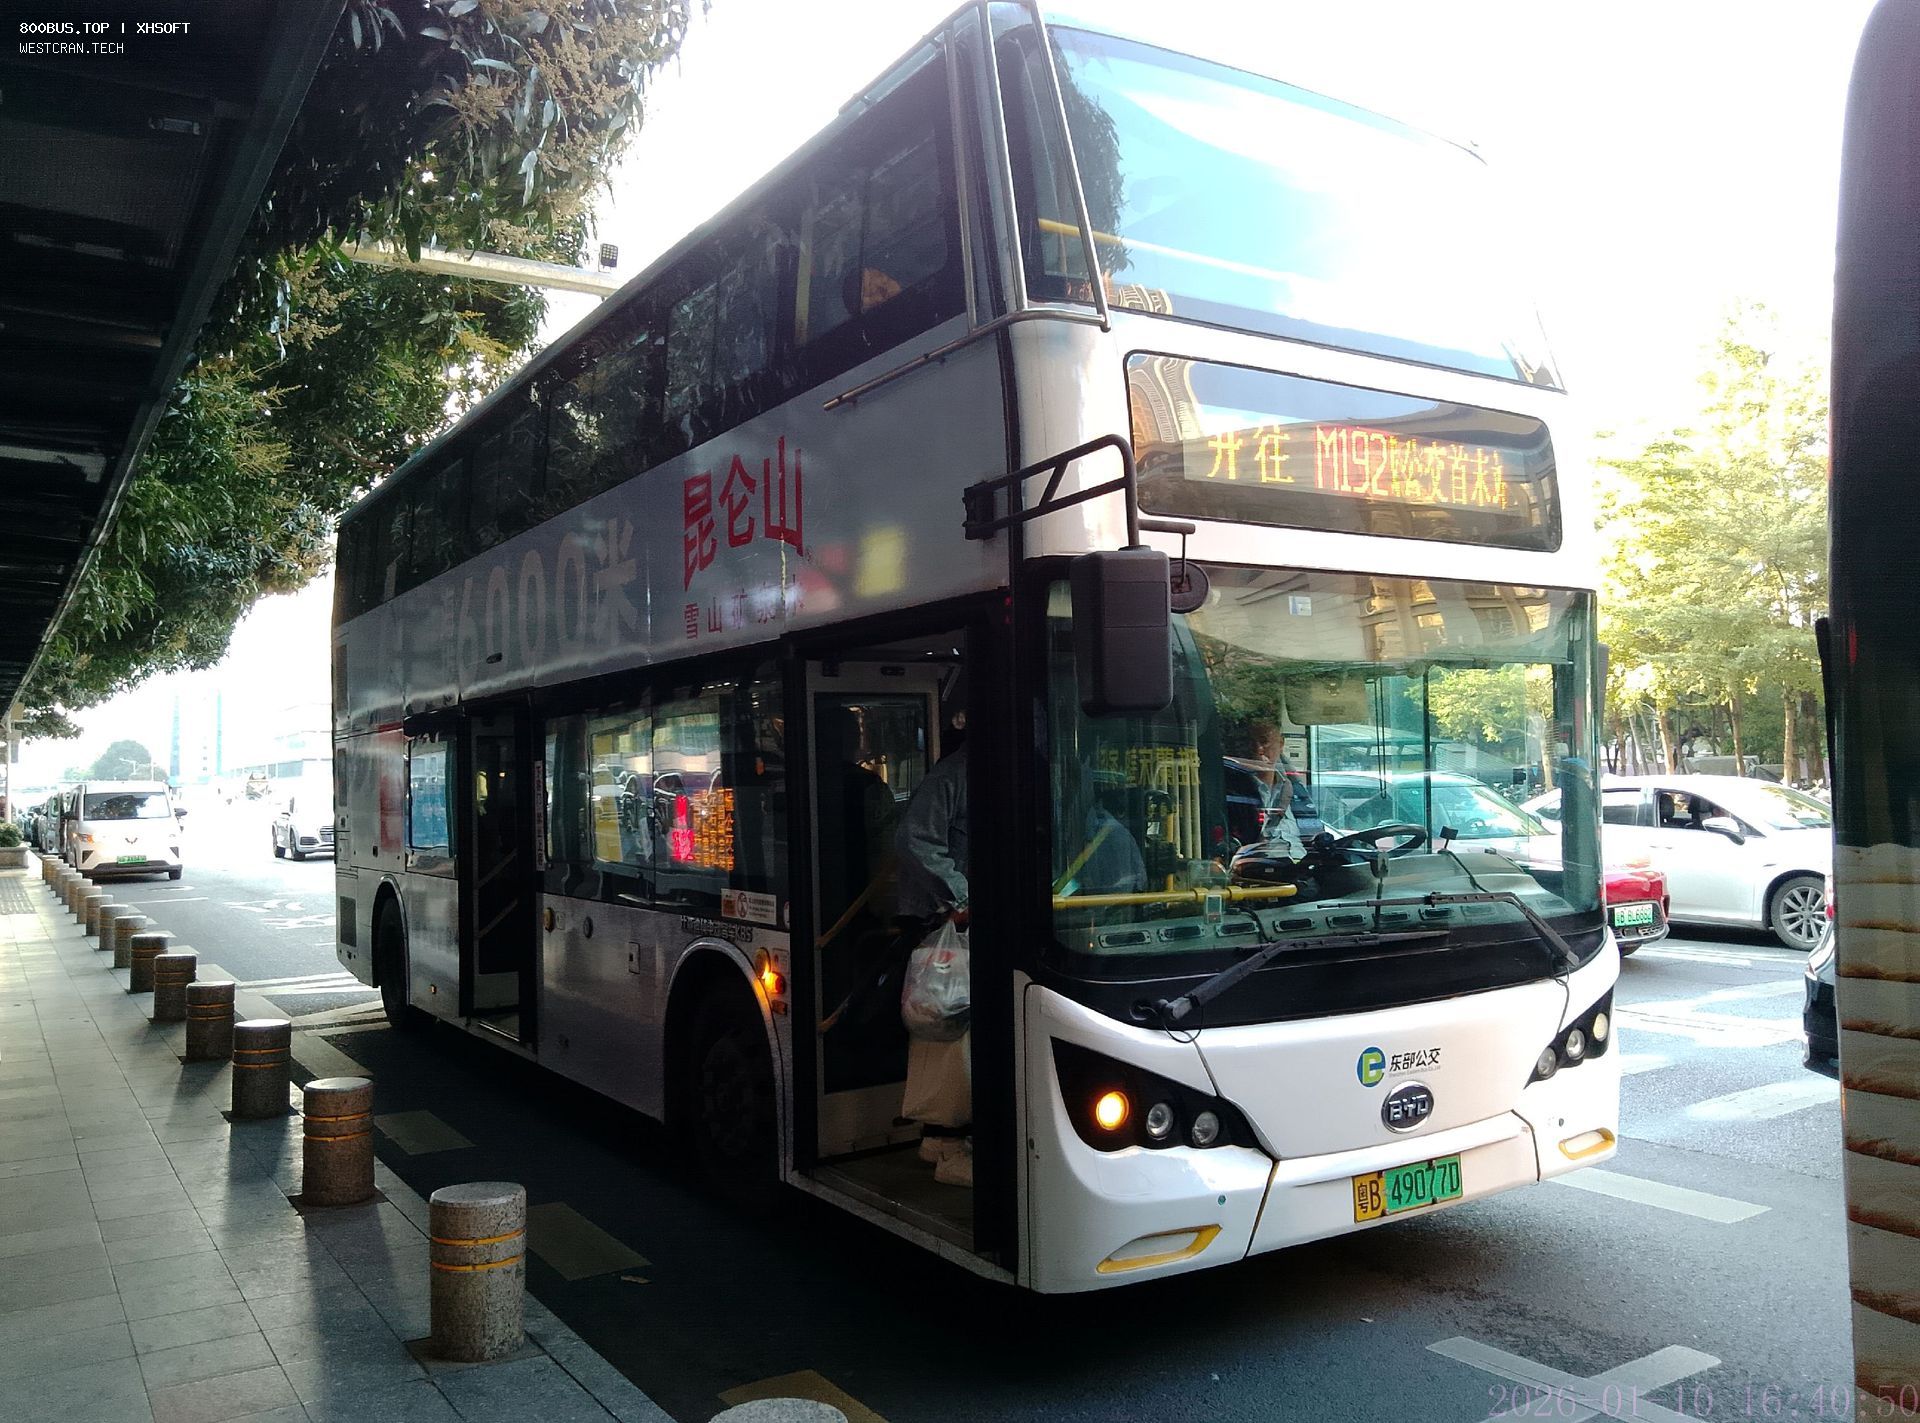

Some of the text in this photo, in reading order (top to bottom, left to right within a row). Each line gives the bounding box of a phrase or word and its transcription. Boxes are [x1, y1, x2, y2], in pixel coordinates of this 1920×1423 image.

[1315, 425, 1390, 496] M192
[683, 436, 803, 592] 昆仑山
[1389, 1048, 1441, 1072] 东部公交
[1389, 1094, 1429, 1121] BYD
[1357, 1180, 1381, 1212] 粤B
